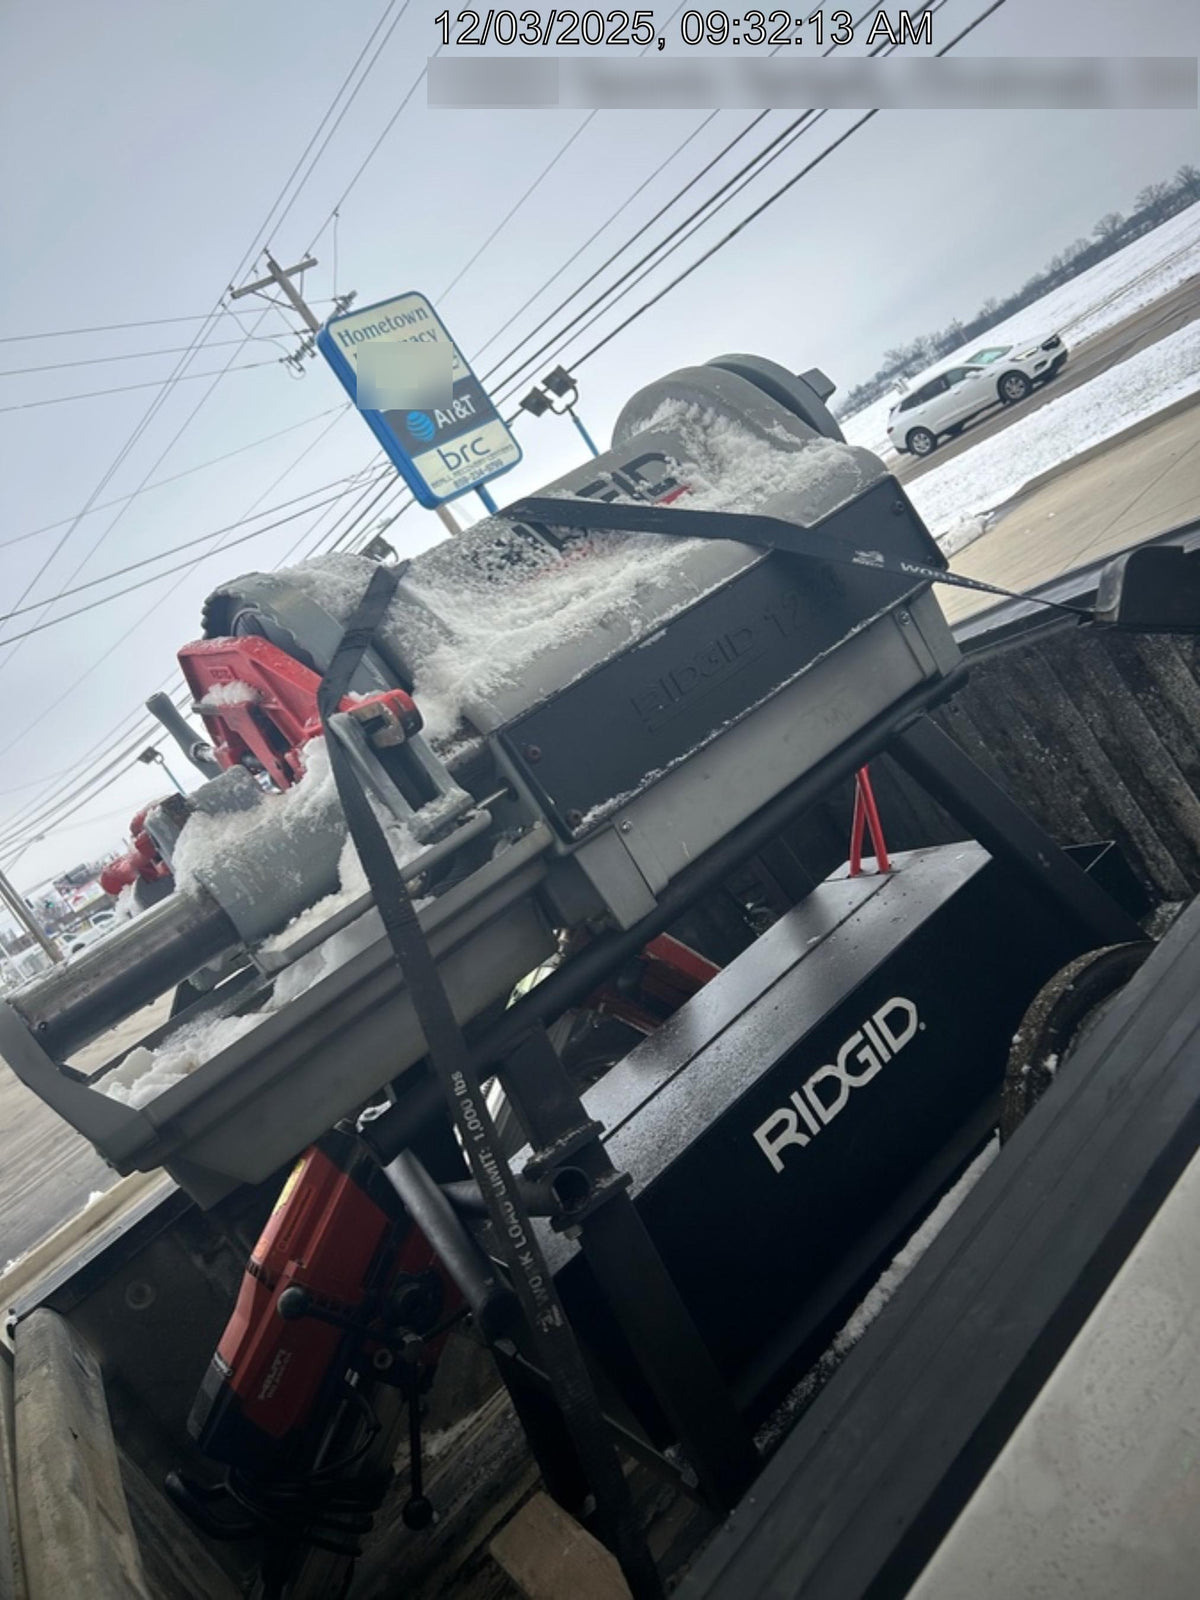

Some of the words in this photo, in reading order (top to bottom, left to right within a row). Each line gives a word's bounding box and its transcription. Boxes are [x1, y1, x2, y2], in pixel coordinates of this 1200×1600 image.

[337, 307, 428, 347] Hometown
[437, 436, 491, 471] brc
[753, 996, 918, 1173] RIDGID
